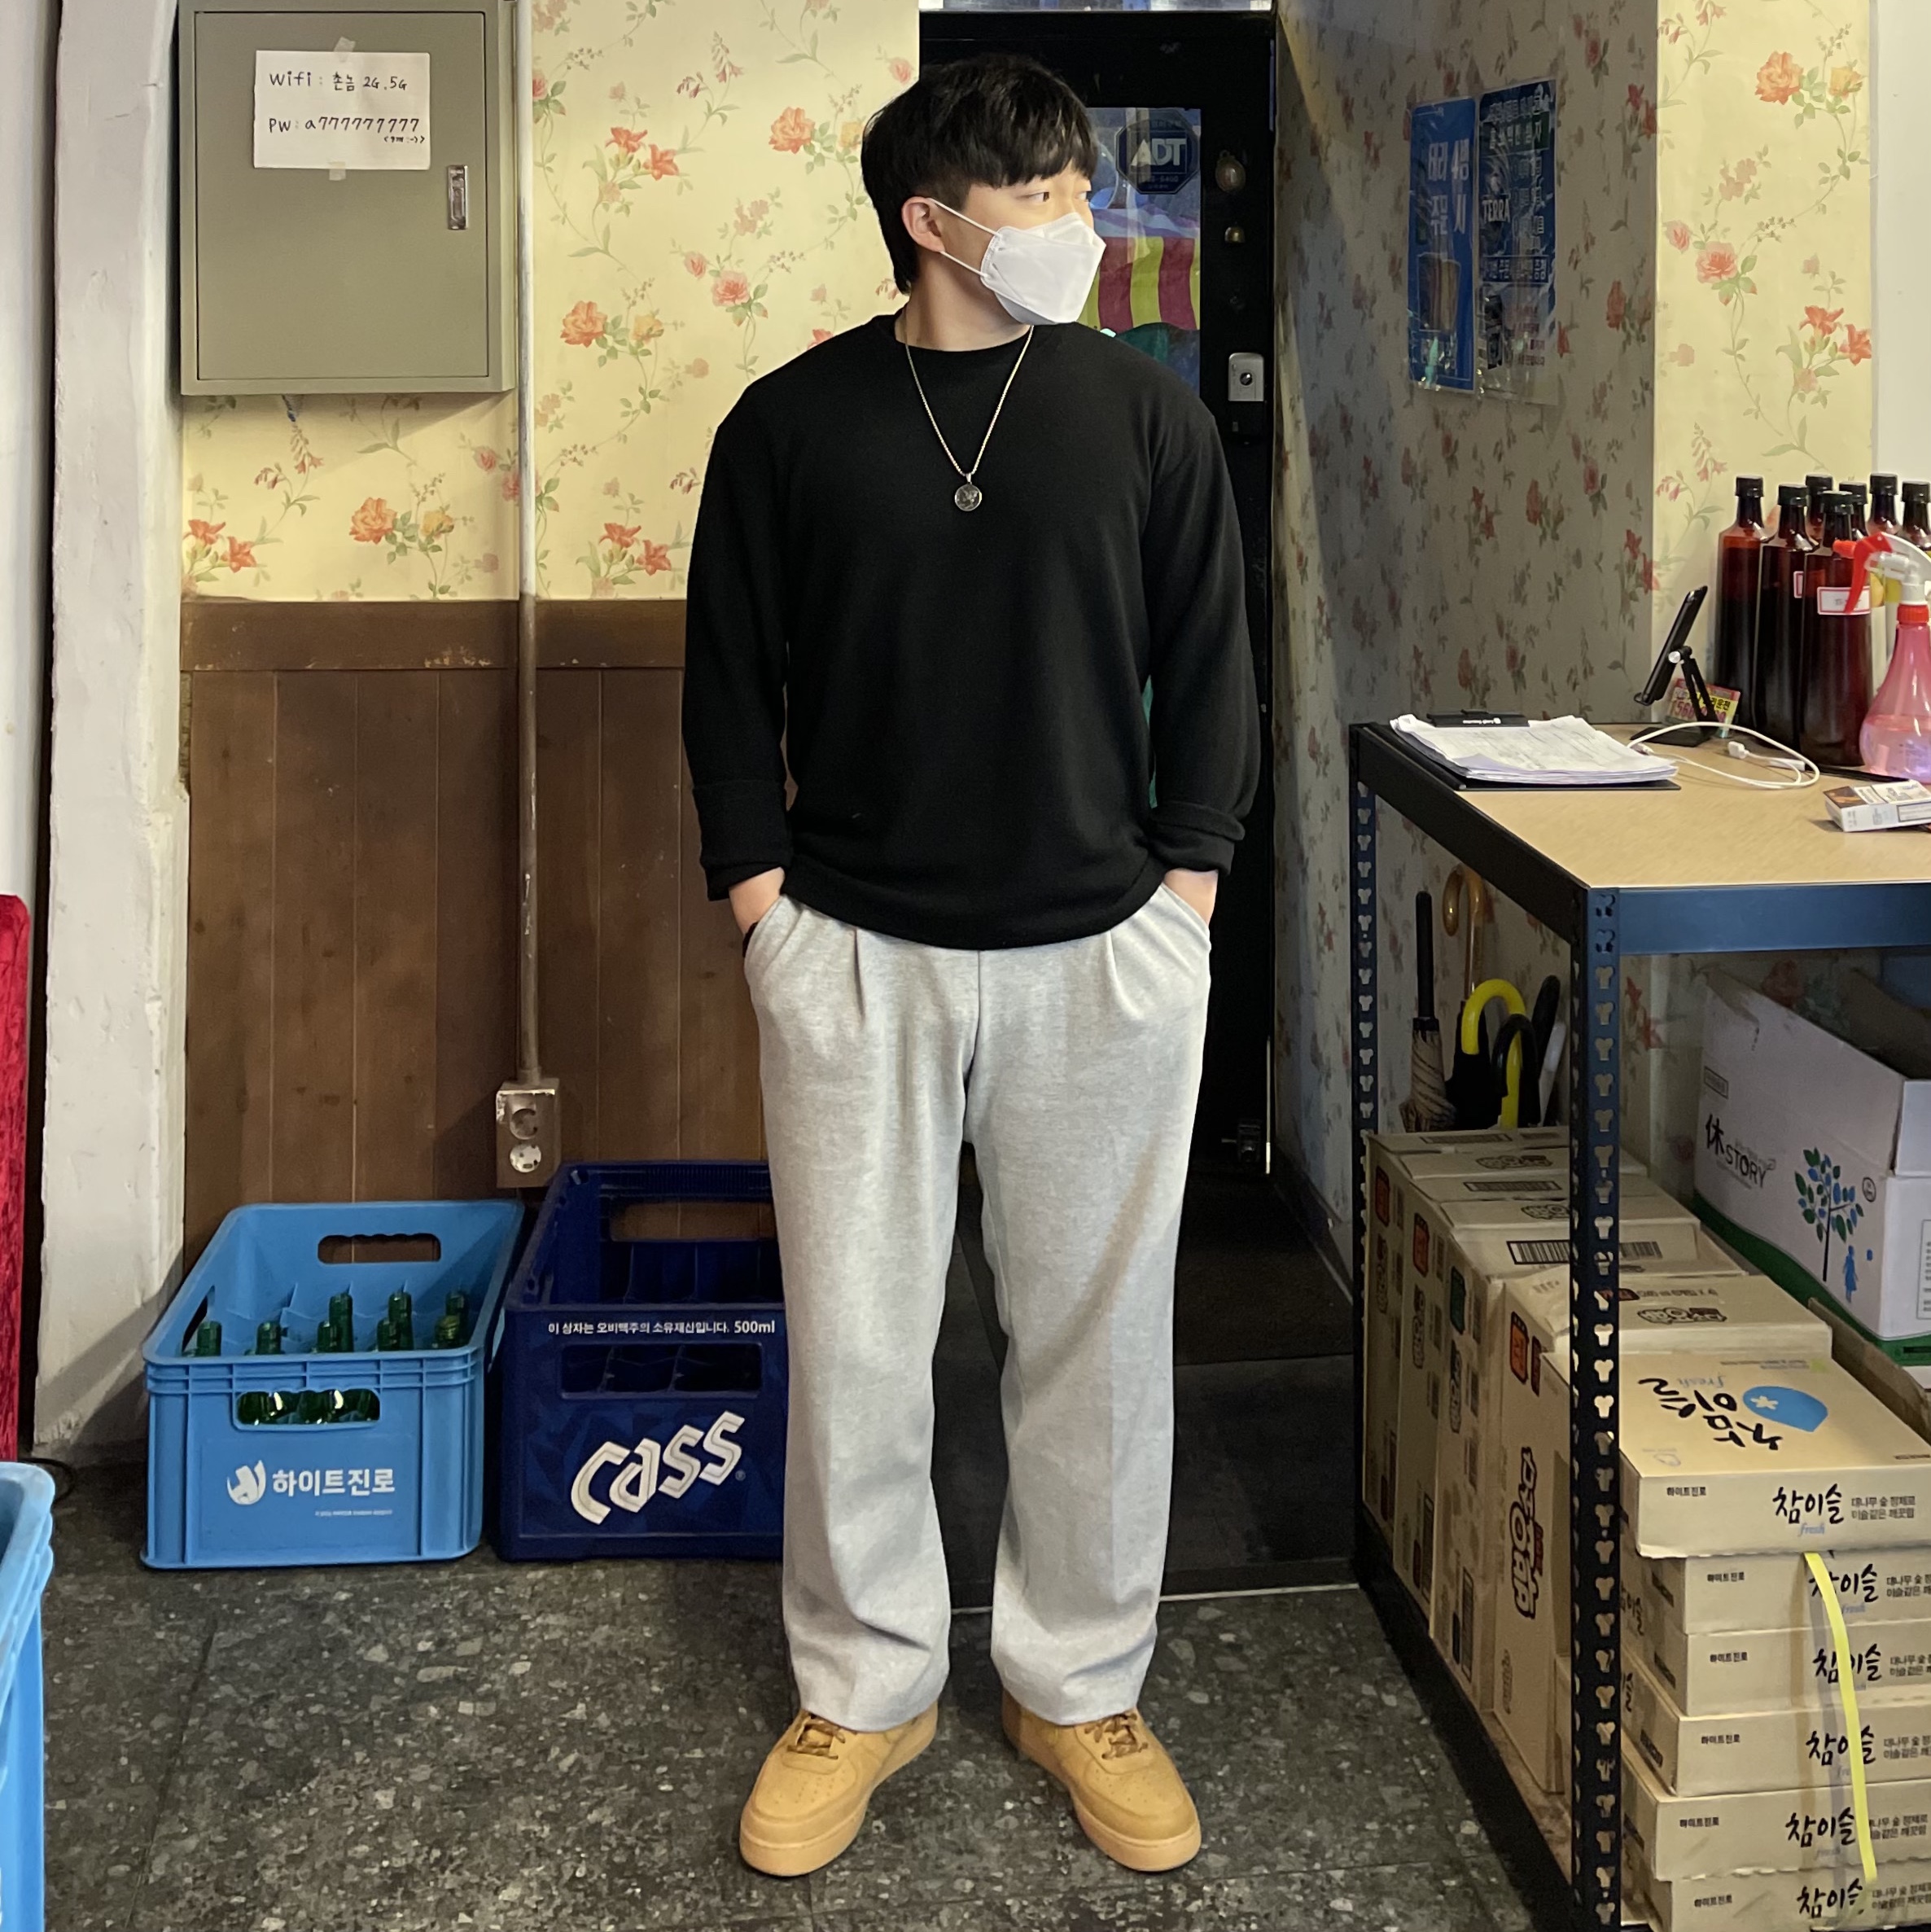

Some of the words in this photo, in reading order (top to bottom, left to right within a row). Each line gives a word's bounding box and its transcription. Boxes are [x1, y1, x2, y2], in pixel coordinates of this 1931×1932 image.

[1131, 138, 1187, 166] ADT
[1482, 199, 1510, 224] TERRA
[548, 1322, 559, 1335] 이
[733, 1319, 775, 1334] 500ml
[272, 1468, 396, 1497] 하이트진로
[1666, 1486, 1707, 1497] 하이트진로
[1772, 1483, 1845, 1525] 참이슬
[1797, 1522, 1825, 1538] fresh
[1785, 1807, 1856, 1848] 참이슬
